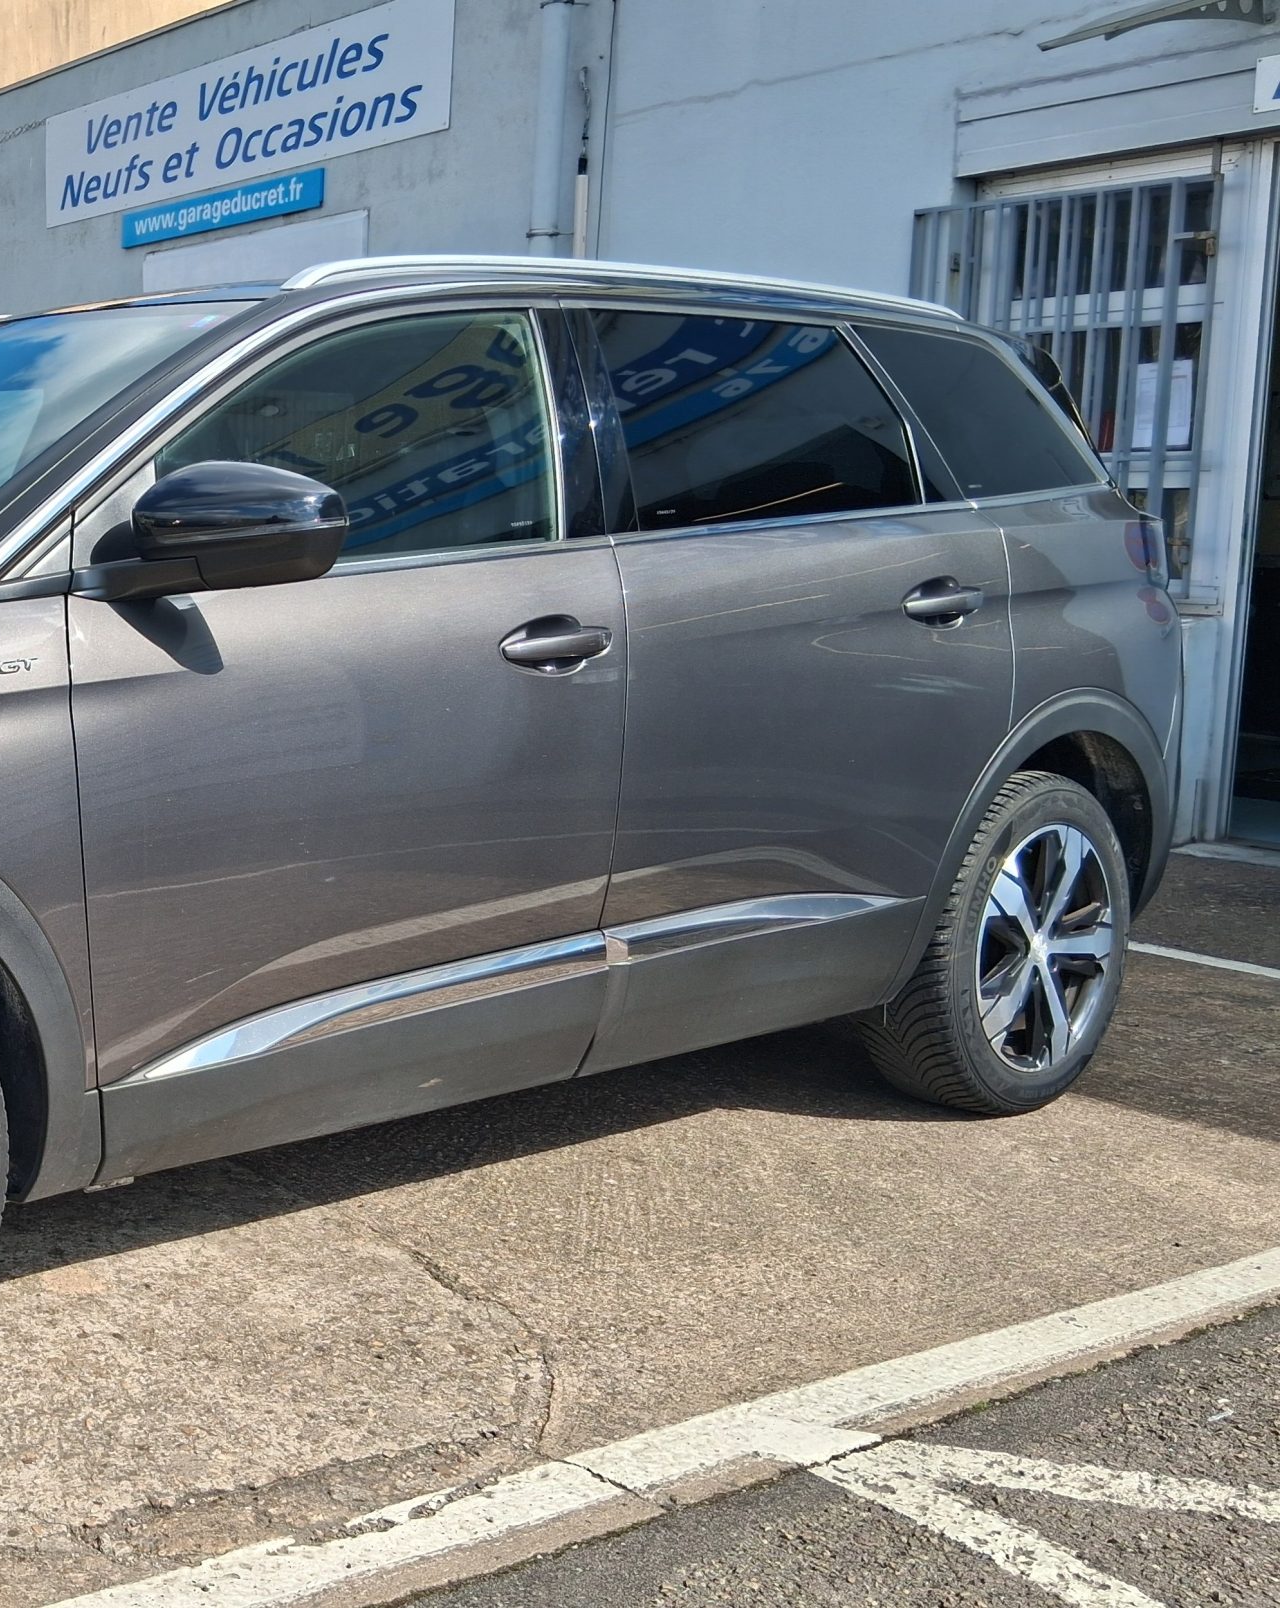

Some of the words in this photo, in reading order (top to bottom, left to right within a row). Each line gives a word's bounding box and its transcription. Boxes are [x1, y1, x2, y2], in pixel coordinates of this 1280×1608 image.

[86, 100, 178, 155] Vente
[197, 32, 390, 121] Véhicules
[60, 157, 154, 211] Neufs
[162, 142, 200, 184] et
[215, 83, 423, 170] Occasions
[133, 177, 305, 236] www.garageducret.fr
[964, 856, 998, 944] KUMHO
